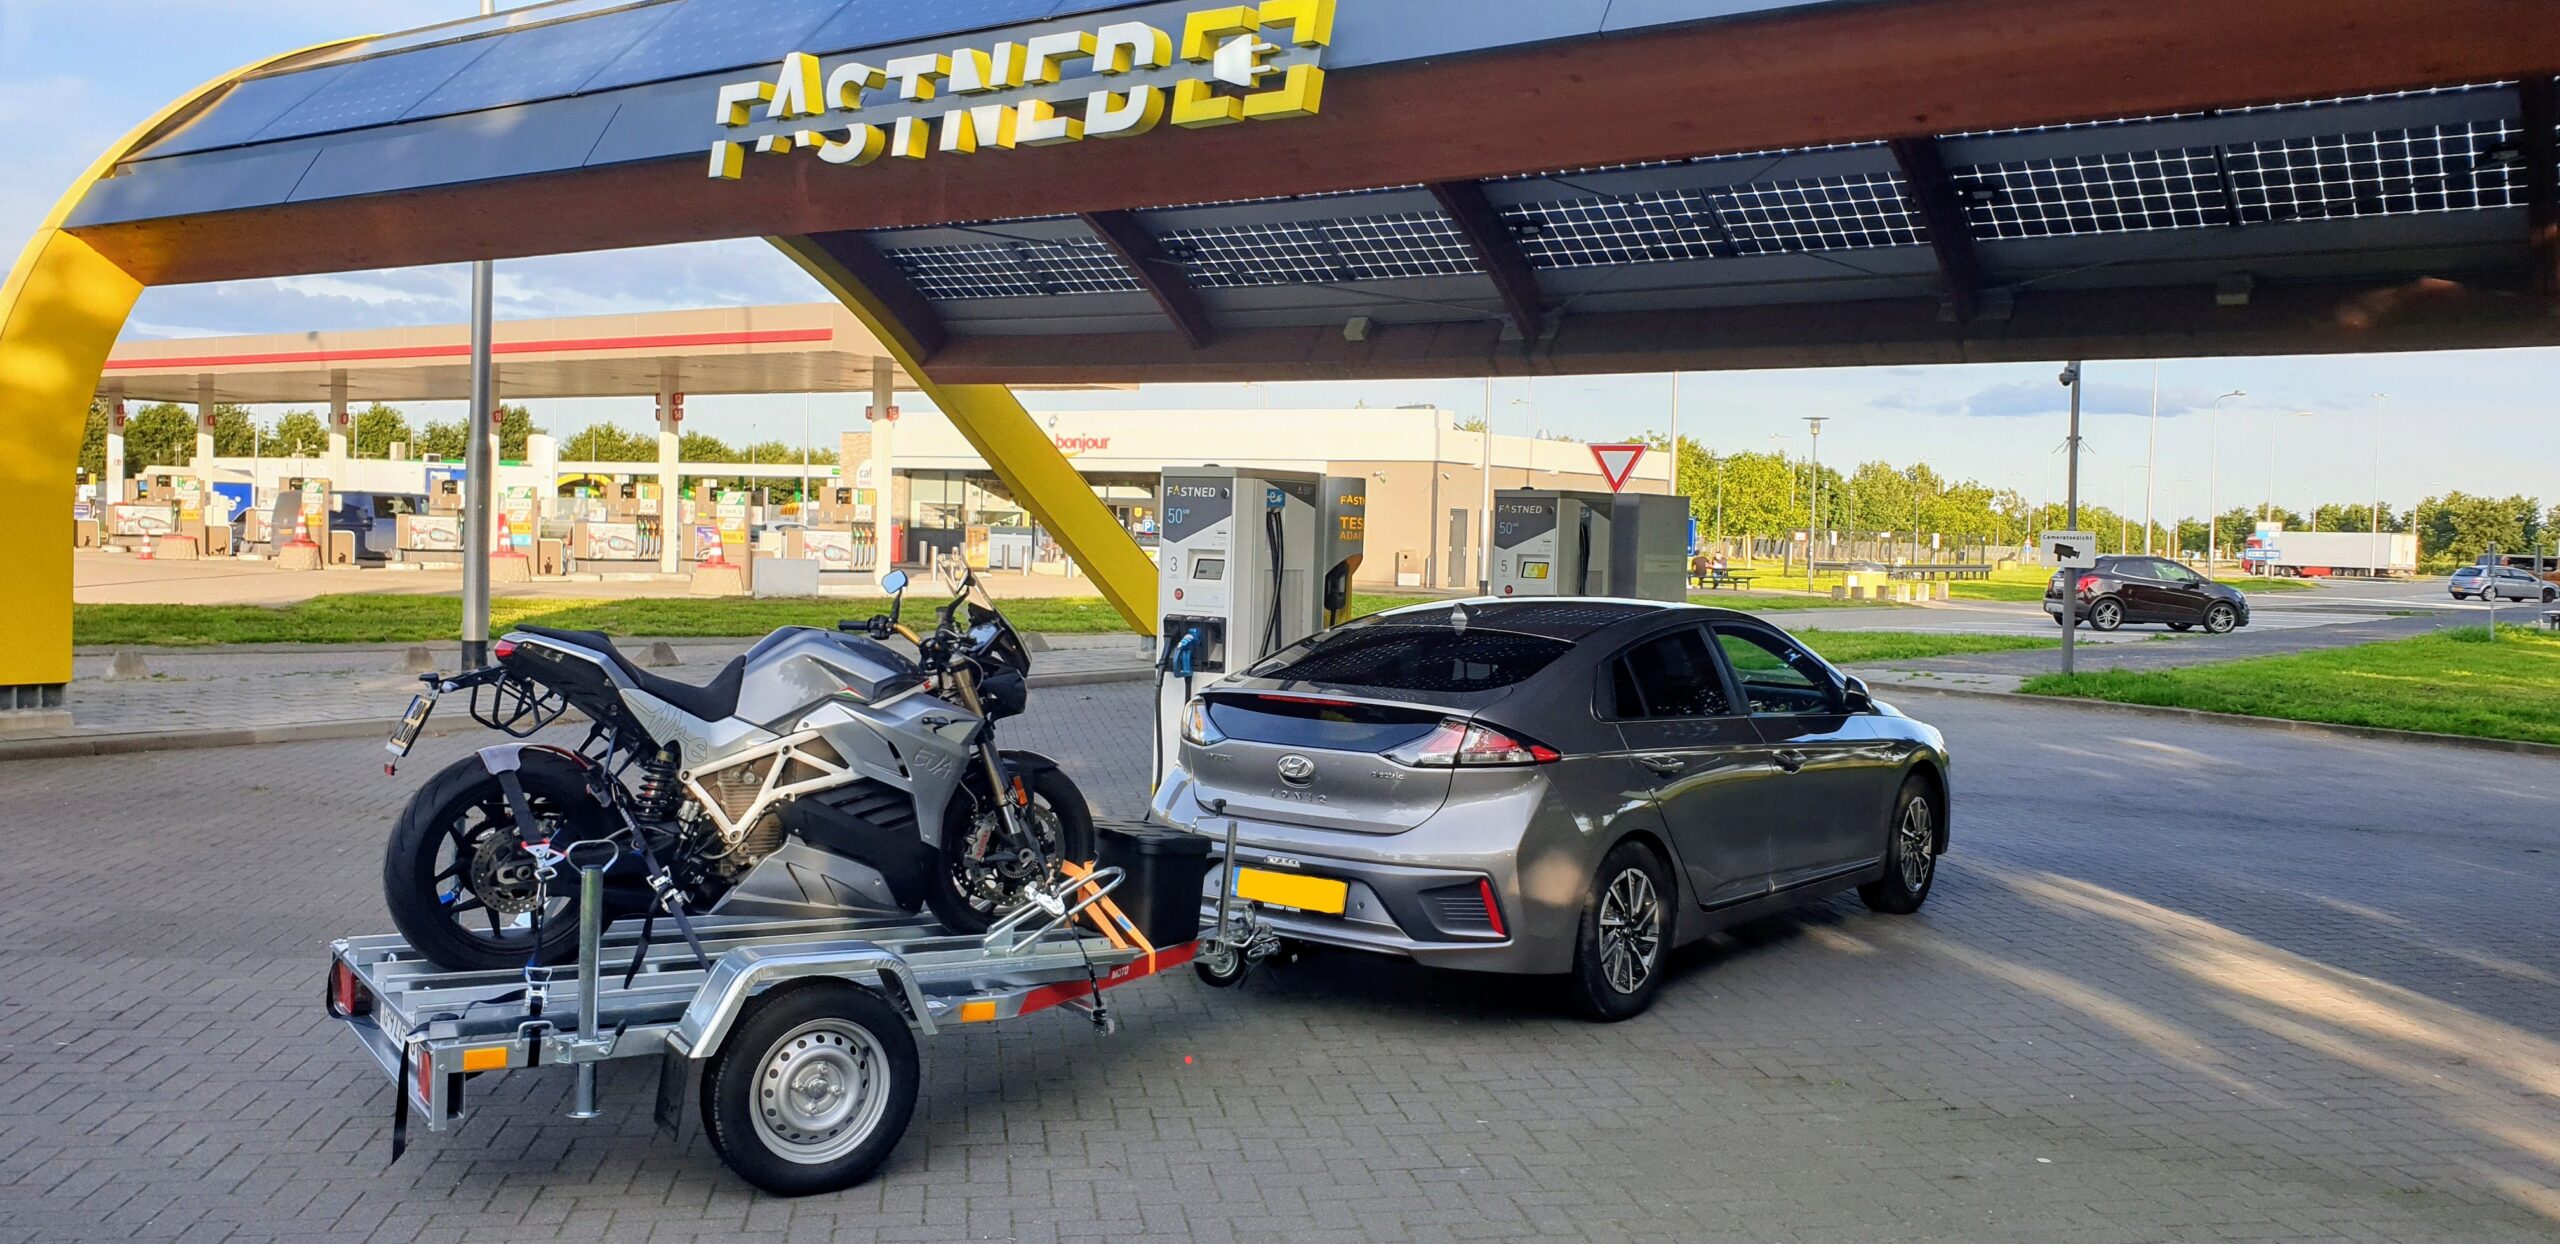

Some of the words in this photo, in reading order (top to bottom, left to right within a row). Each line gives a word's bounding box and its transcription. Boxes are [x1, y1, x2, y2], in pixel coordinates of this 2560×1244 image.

[708, 20, 1172, 180] FASTNED
[1056, 433, 1110, 453] bonjour
[1167, 485, 1216, 498] FASTNED
[1498, 504, 1543, 514] FASTNED
[1170, 556, 1178, 572] 3
[1501, 560, 1508, 573] 5
